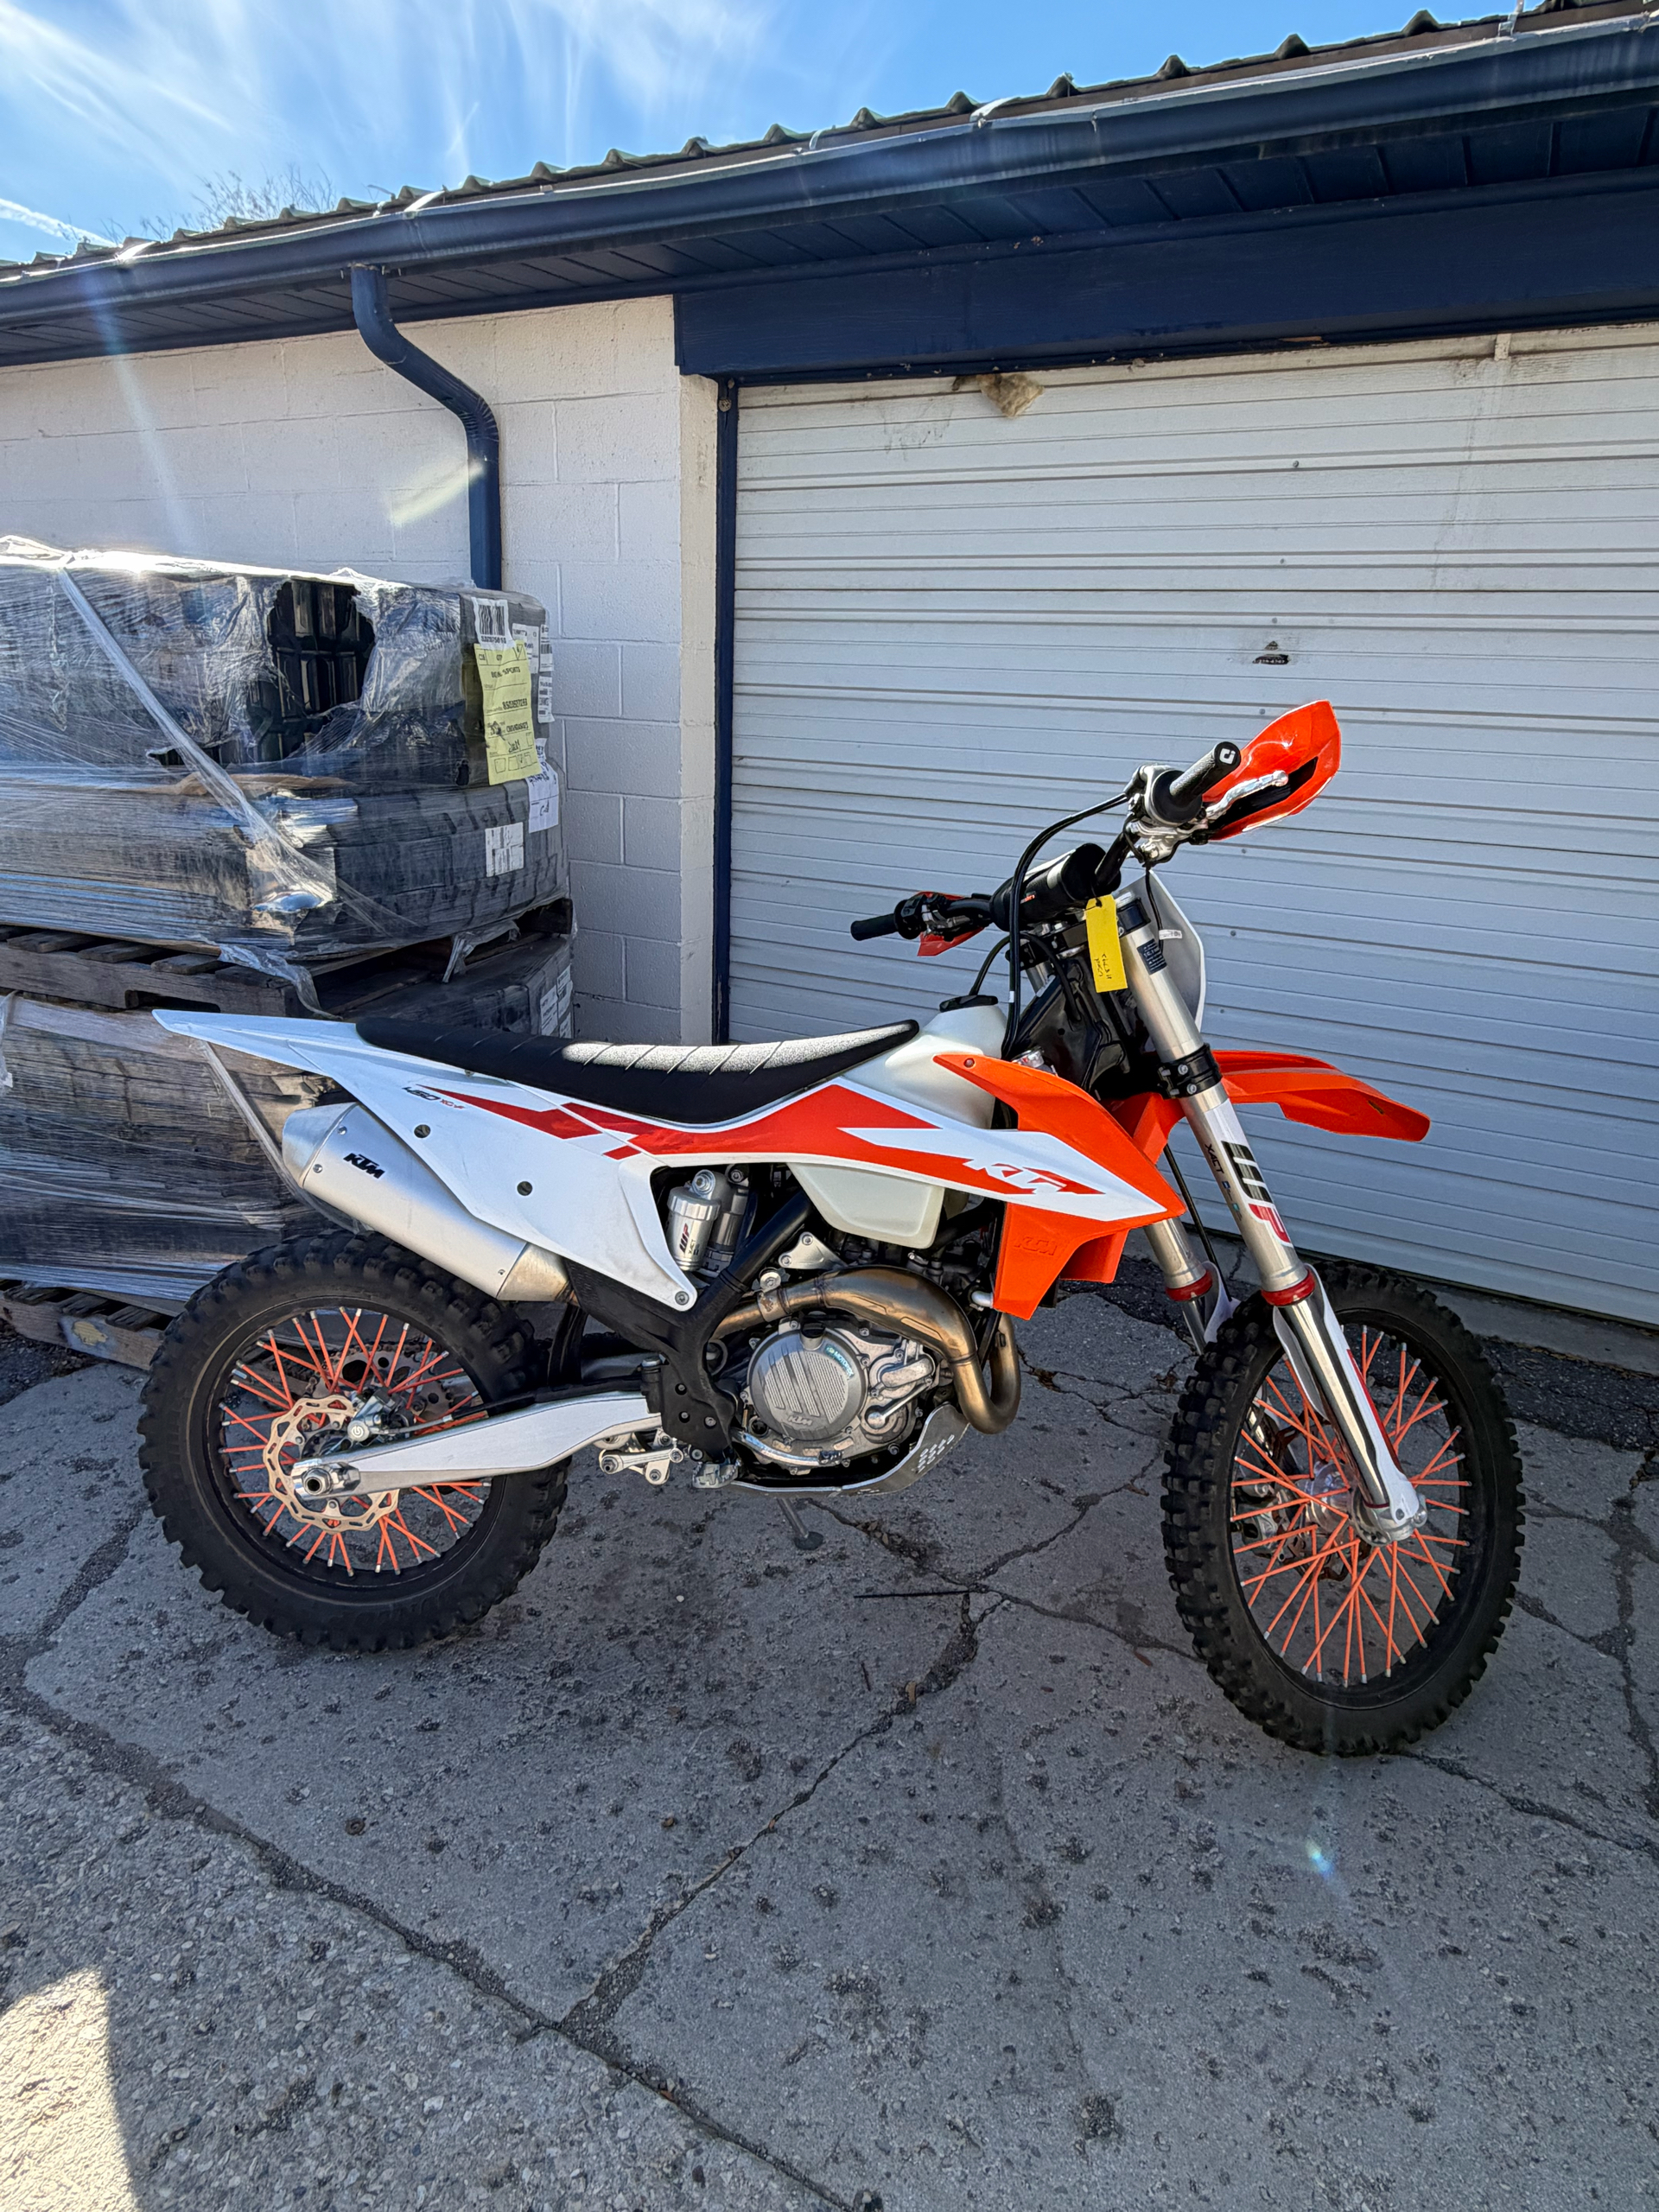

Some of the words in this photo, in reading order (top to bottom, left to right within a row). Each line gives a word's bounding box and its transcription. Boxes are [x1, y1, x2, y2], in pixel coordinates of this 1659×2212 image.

[402, 1087, 441, 1101] 450
[343, 1153, 385, 1179] KTM
[1205, 1143, 1224, 1174] XACT
[962, 1159, 1071, 1195] KTM
[788, 1415, 812, 1426] KTM
